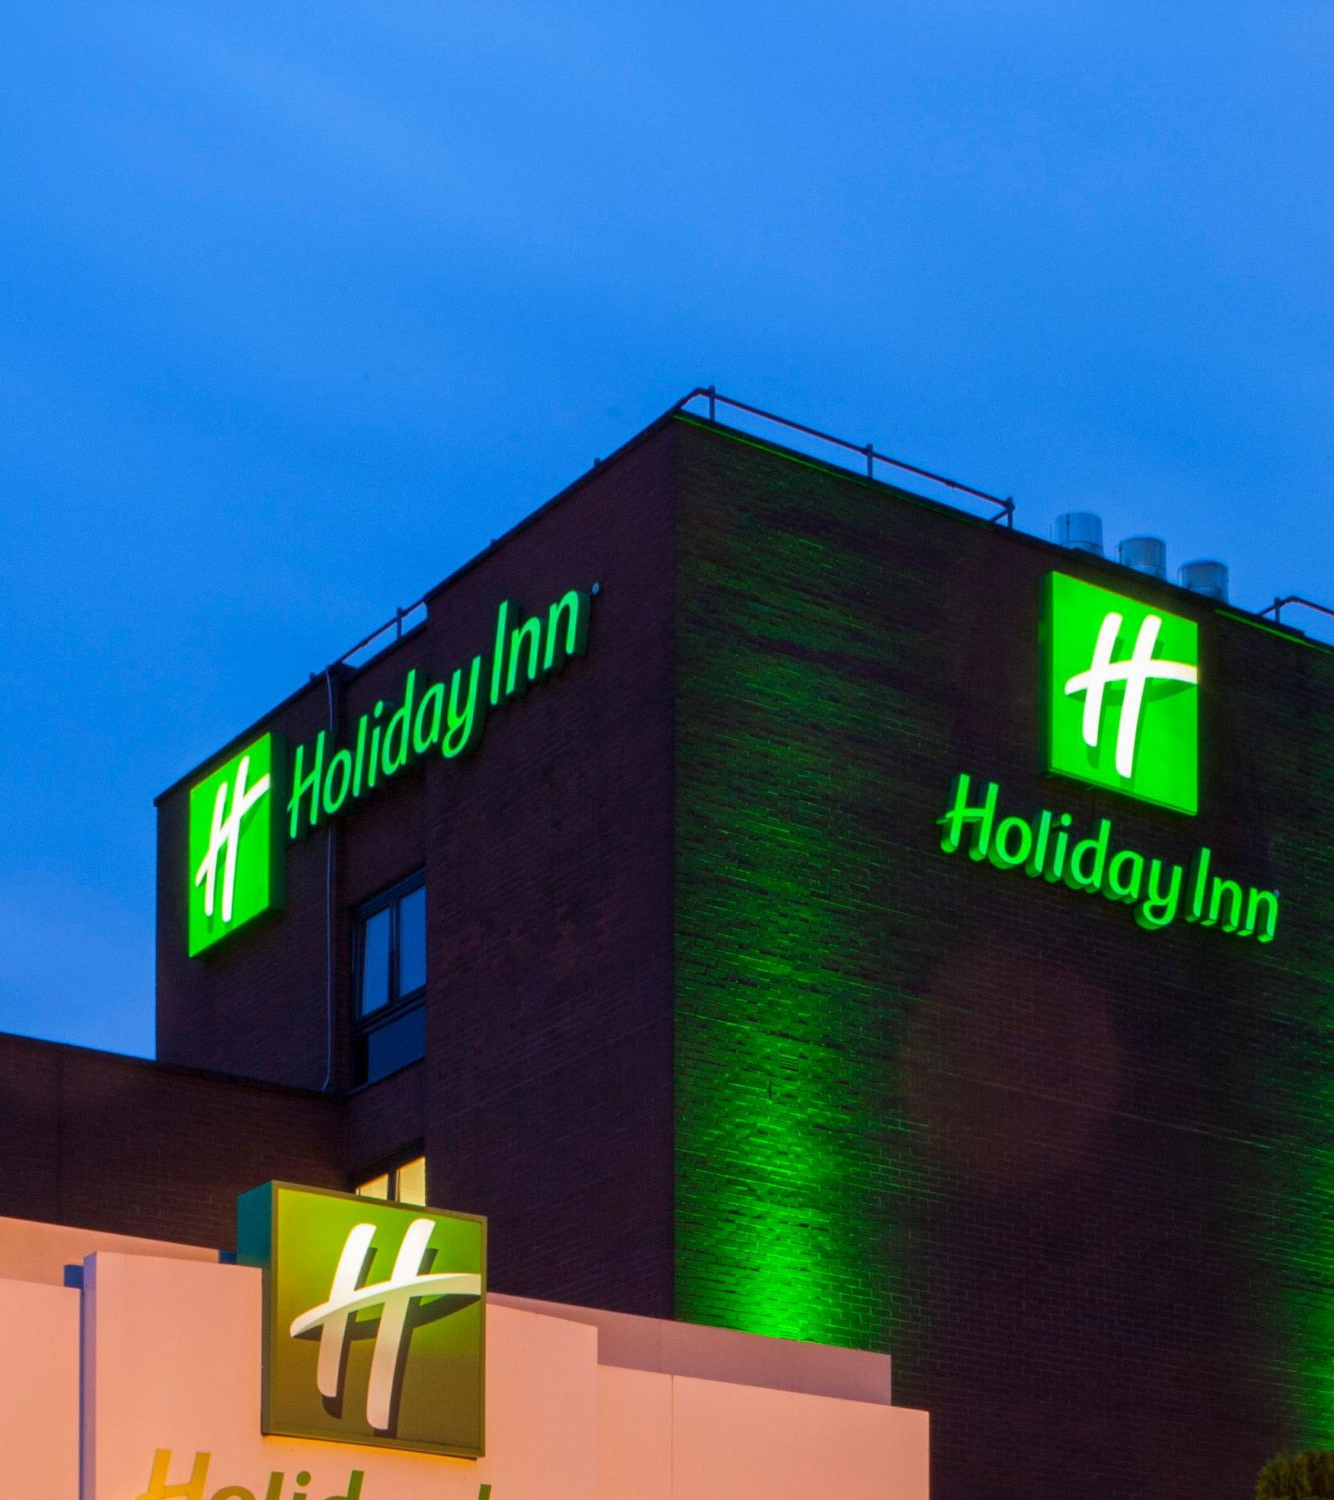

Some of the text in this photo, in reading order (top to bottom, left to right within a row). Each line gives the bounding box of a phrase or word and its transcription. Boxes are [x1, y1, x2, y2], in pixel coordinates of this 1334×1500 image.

[287, 589, 581, 839] Holiday Inn
[937, 773, 1279, 942] Holiday Inn
